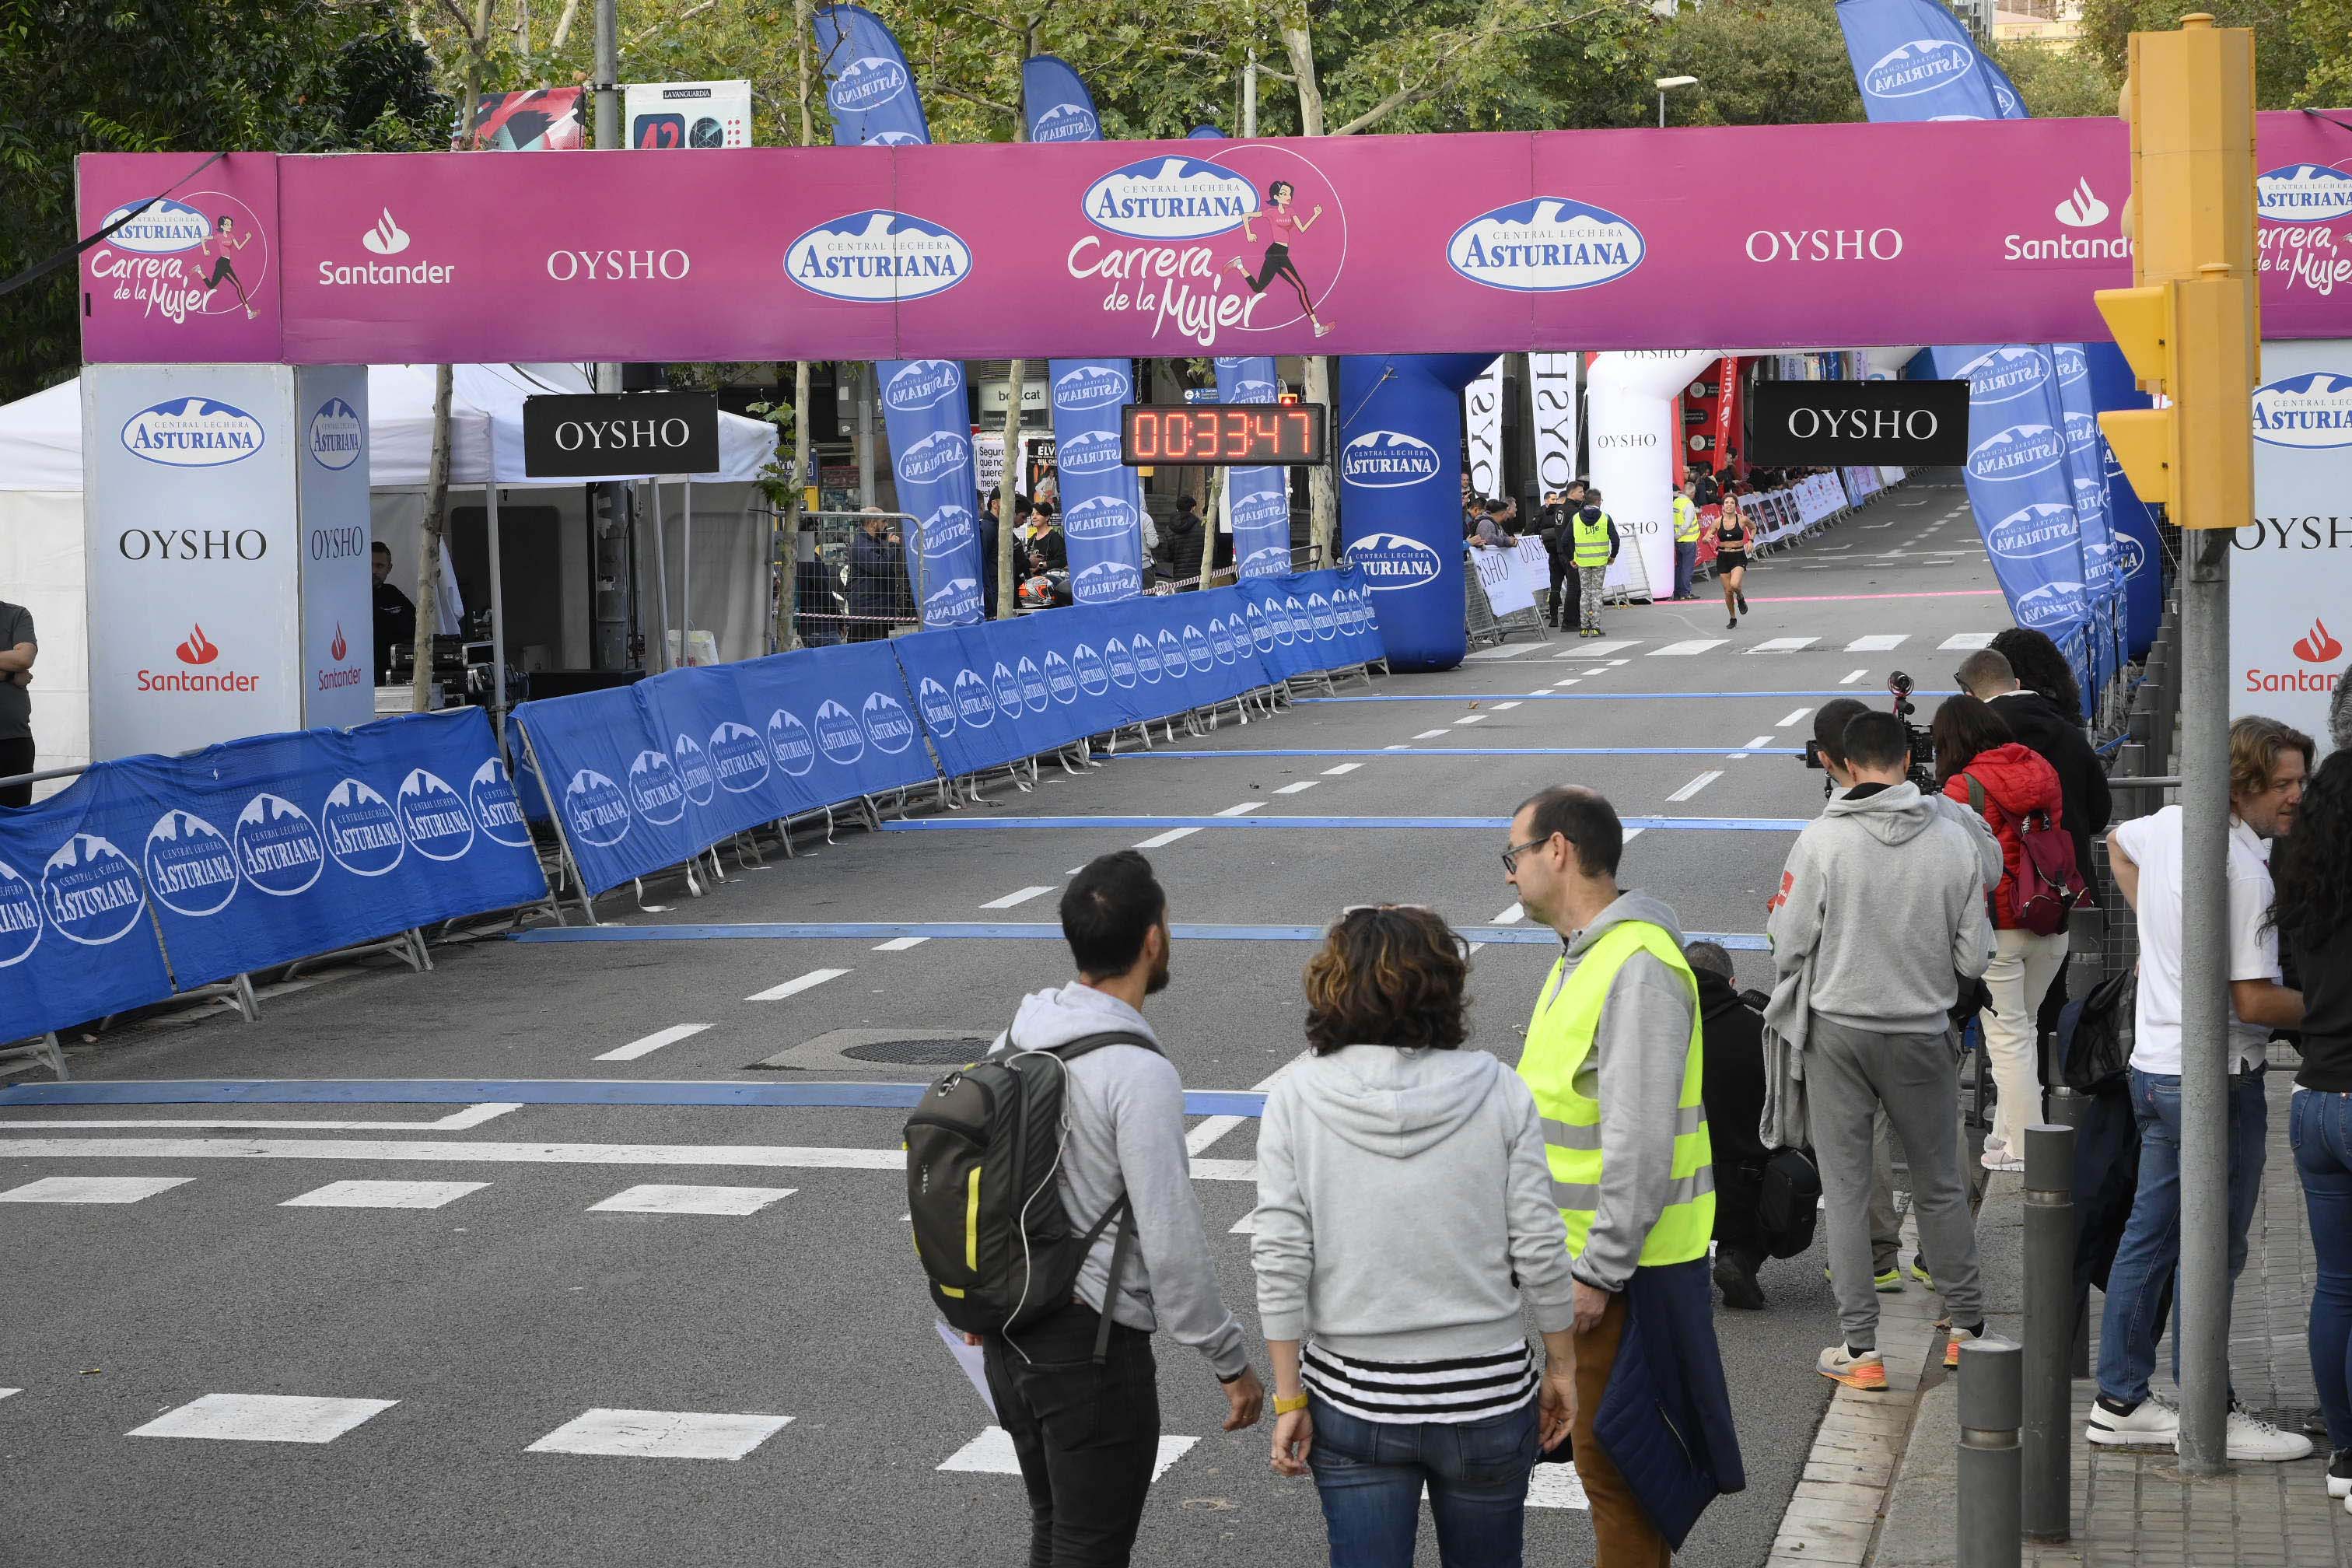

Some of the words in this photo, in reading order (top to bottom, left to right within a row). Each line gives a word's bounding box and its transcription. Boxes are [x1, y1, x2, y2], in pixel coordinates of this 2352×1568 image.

[1185, 184, 1241, 192] LECHERA
[1095, 187, 1245, 219] ASTURIANA
[828, 242, 887, 251] CENTRAL
[892, 241, 951, 250] LECHERA
[1493, 229, 1554, 240] CENTRAL
[1560, 228, 1623, 239] LECHERA
[1745, 228, 1903, 262] OYSHO
[2004, 233, 2132, 261] Santand
[2257, 226, 2332, 250] arrera
[90, 249, 183, 279] Carrera
[547, 249, 691, 281] OYSHO
[798, 244, 958, 278] ASTURIANA
[1067, 235, 1213, 279] Carrera
[1461, 233, 1629, 268] ASTURIANA
[318, 260, 455, 285] Santander
[2275, 249, 2290, 271] la
[2286, 245, 2352, 296] Muje
[114, 279, 131, 300] de
[135, 279, 147, 300] la
[144, 275, 218, 324] Mujer
[1103, 282, 1130, 311] de
[1136, 279, 1155, 311] la
[1150, 273, 1268, 347] Mujer
[2274, 399, 2327, 408] CENTRAL
[133, 422, 254, 449] ASTURIANA
[555, 418, 690, 451] OYSHO
[1135, 412, 1310, 456] 00:33:47
[1788, 408, 1938, 439] OYSHO
[313, 425, 359, 453] ASTURIANA
[1598, 433, 1657, 449] OYSHO
[980, 459, 993, 470] que
[1344, 453, 1433, 476] ASTURIANA
[1584, 524, 1600, 535] Life
[1621, 520, 1658, 536] SHO
[119, 529, 267, 561] OYSHO
[311, 526, 363, 561] OYSHO
[1348, 555, 1433, 576] TURIANA
[137, 670, 260, 691] Santander
[318, 665, 362, 691] Santander
[250, 828, 278, 842] CENTRAL
[278, 821, 309, 836] LECHERA
[330, 817, 402, 856] ASTURIANA
[404, 806, 471, 842] ASTURIANA
[162, 845, 194, 860] CENTRAL
[242, 835, 321, 876] ASTURIANA
[153, 853, 235, 895] ASTURIANA
